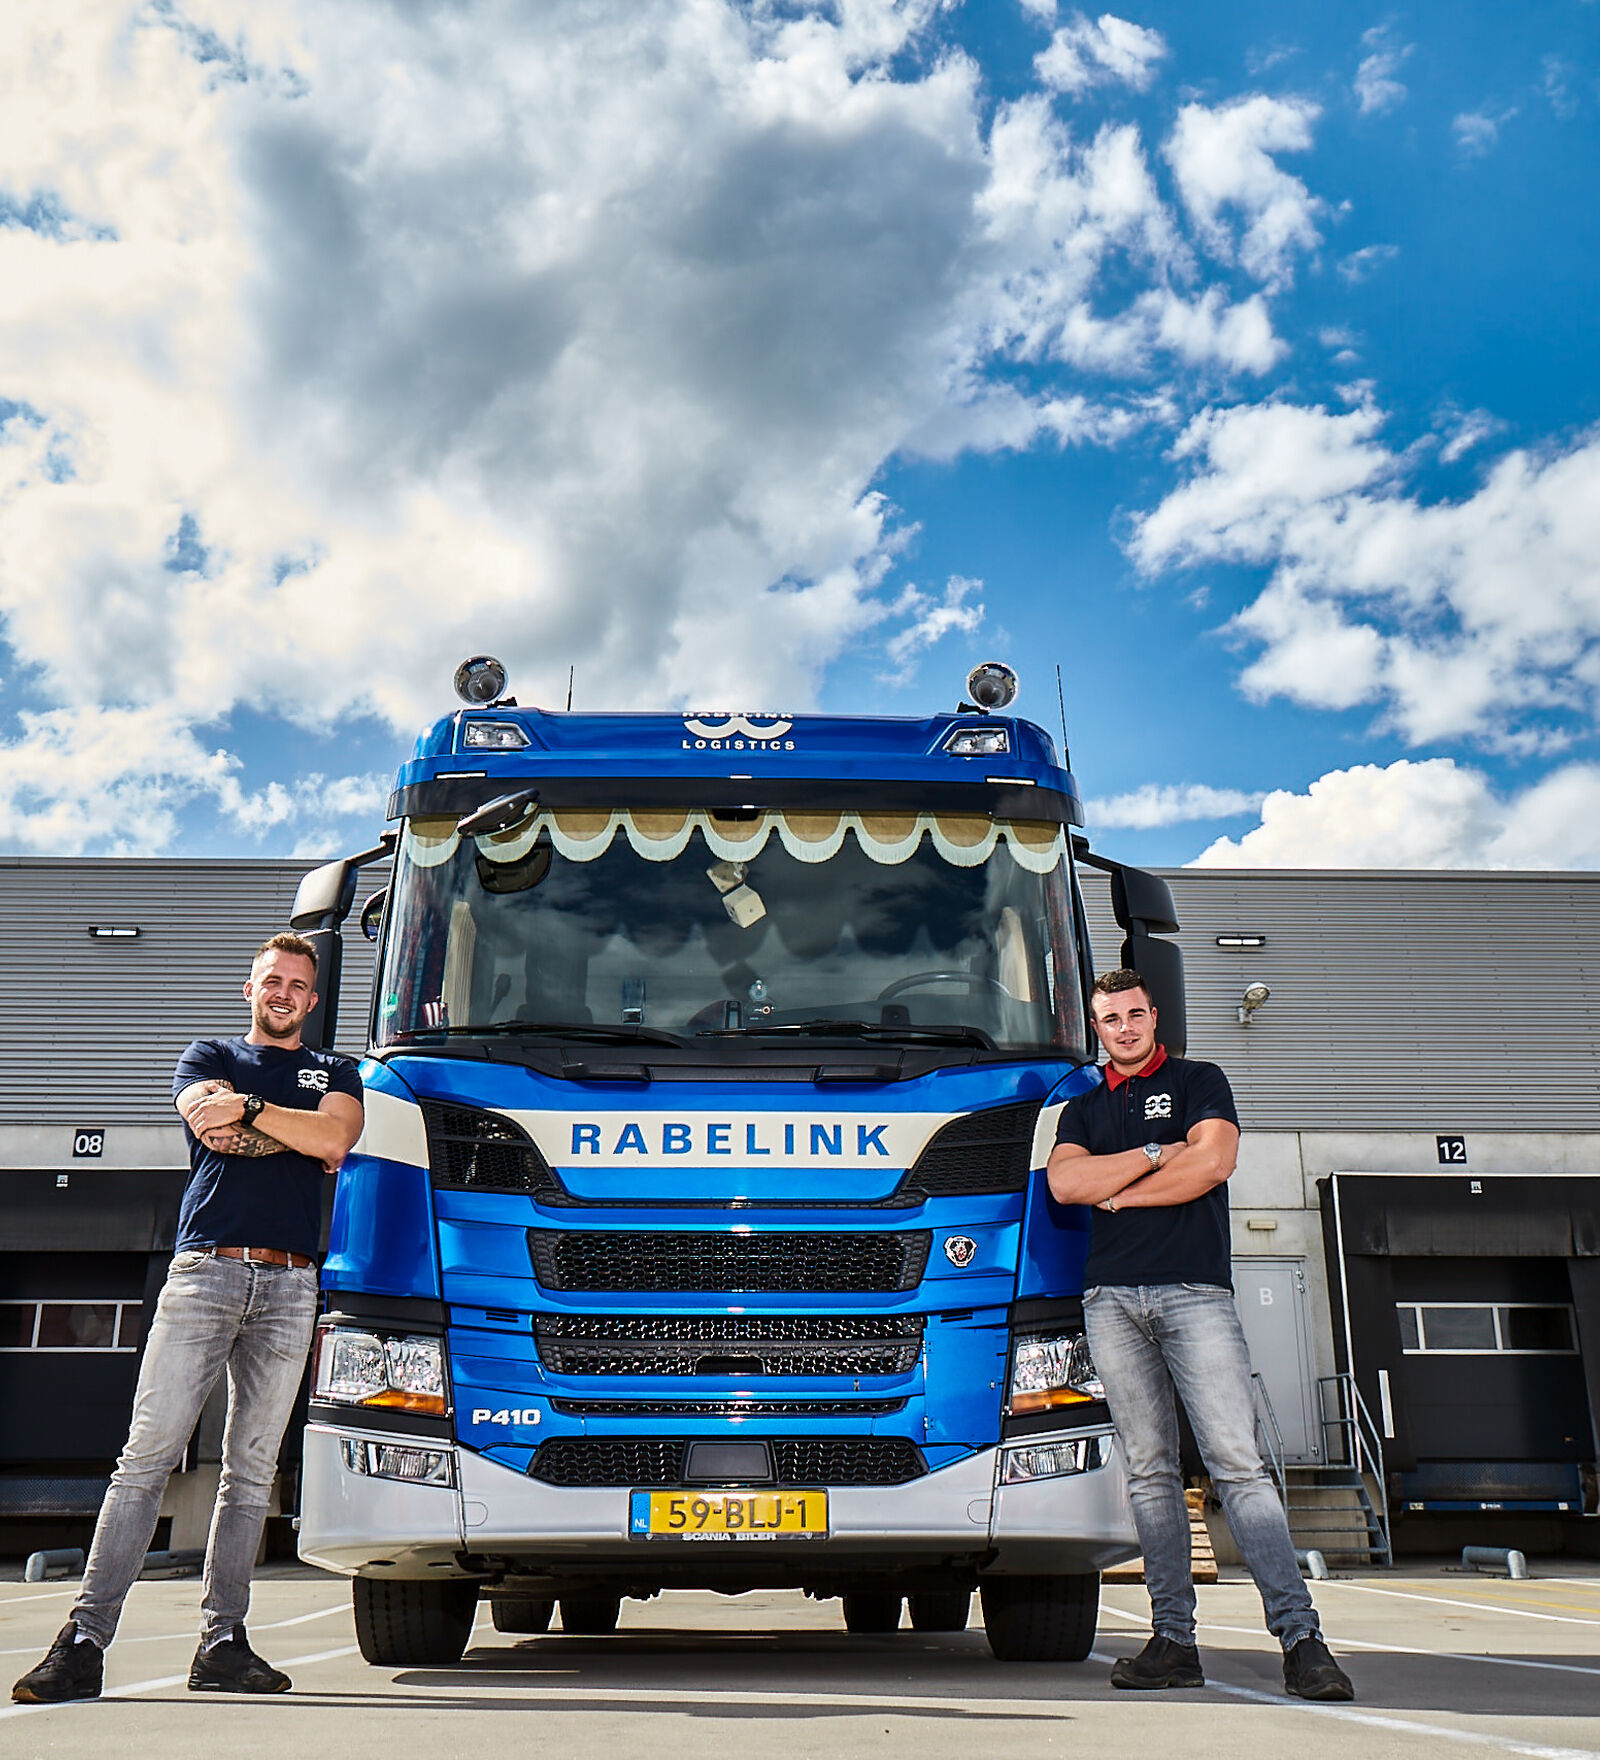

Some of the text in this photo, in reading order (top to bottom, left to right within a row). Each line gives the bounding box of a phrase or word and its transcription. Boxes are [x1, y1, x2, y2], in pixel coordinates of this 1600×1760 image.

[682, 739, 796, 751] LOGISTICS
[75, 1134, 103, 1154] 08
[570, 1123, 891, 1156] RABELINK
[1439, 1141, 1466, 1160] 12
[1259, 1287, 1274, 1306] B
[472, 1408, 542, 1425] P410
[668, 1498, 807, 1529] 59-BLJ-1
[634, 1518, 648, 1529] NL
[682, 1531, 731, 1541] SCANIA
